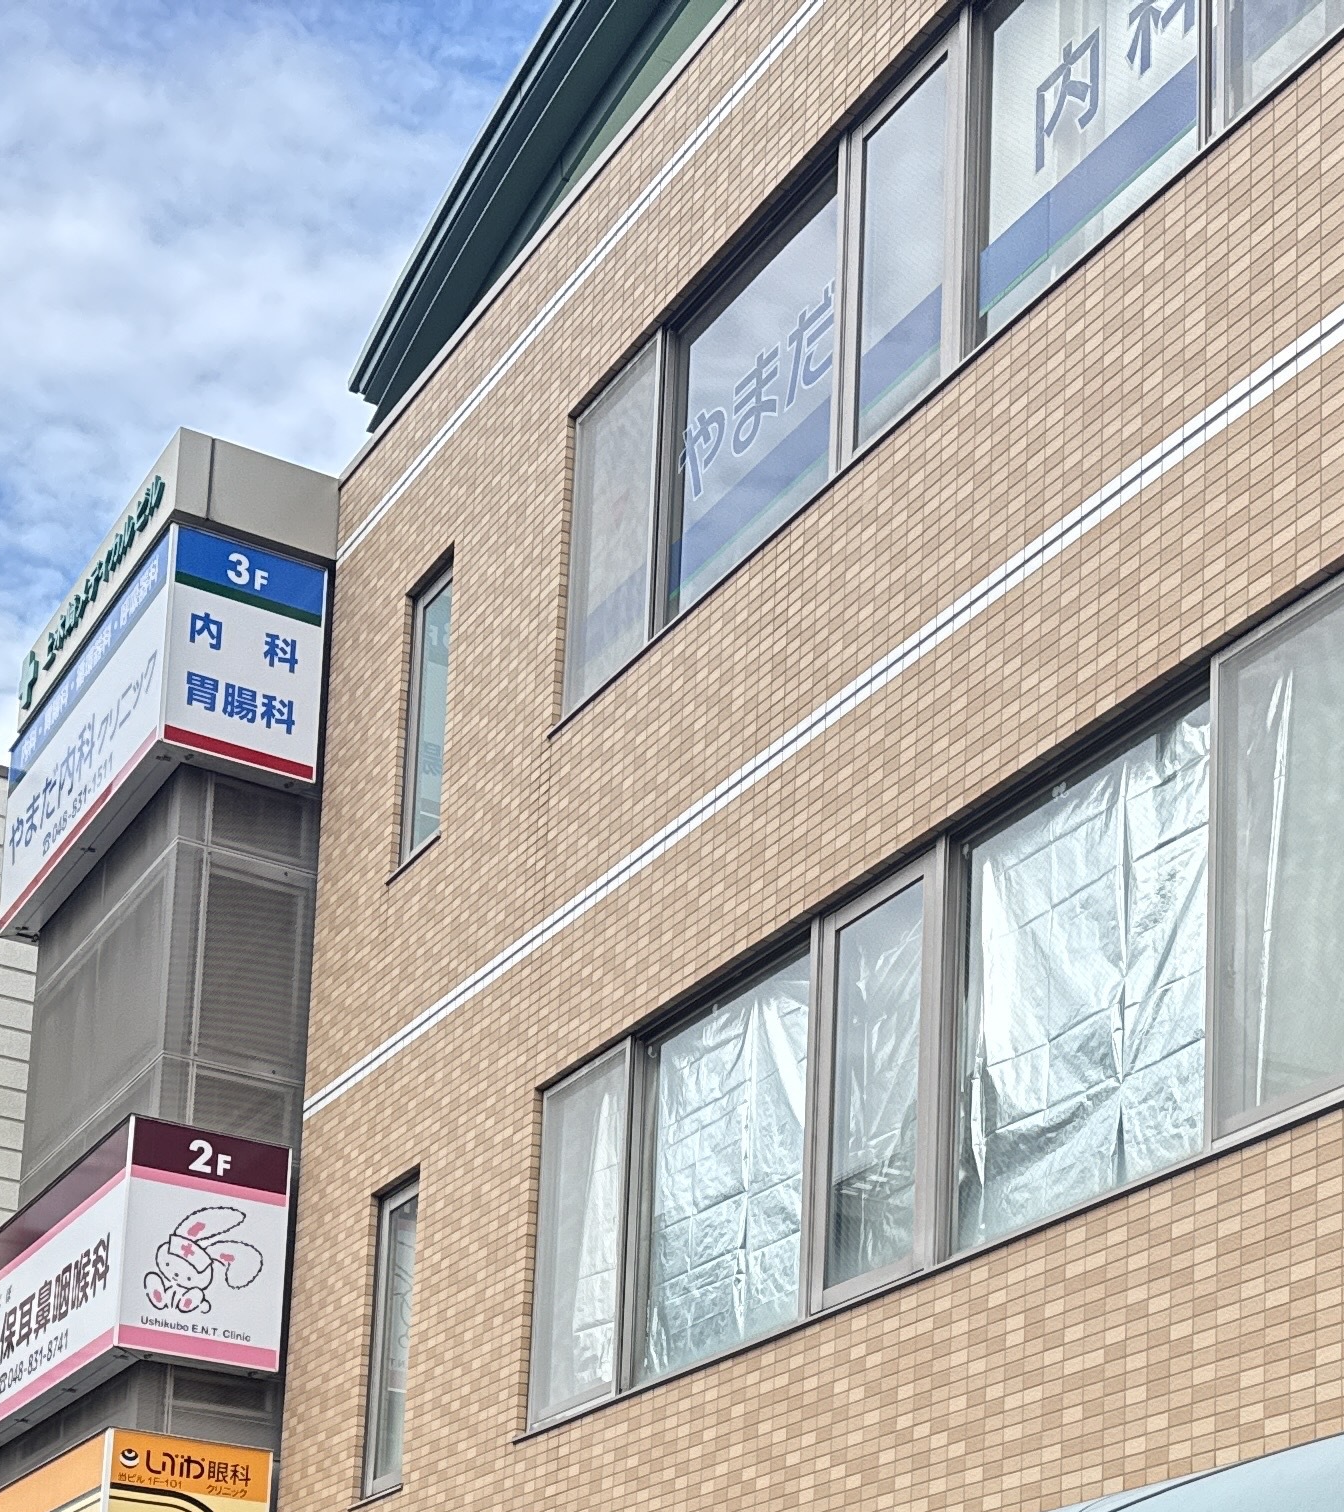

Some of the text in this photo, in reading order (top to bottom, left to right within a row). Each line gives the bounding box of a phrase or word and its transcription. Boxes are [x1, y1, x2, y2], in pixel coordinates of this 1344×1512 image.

[227, 552, 269, 591] 3F
[186, 670, 295, 735] 胃腸科
[9, 649, 157, 865] やまだ内科クリニック
[188, 1139, 232, 1177] 2F
[140, 1315, 189, 1332] Ushikubo
[222, 1329, 251, 1342] Clinic
[206, 1484, 248, 1499] クリニック
